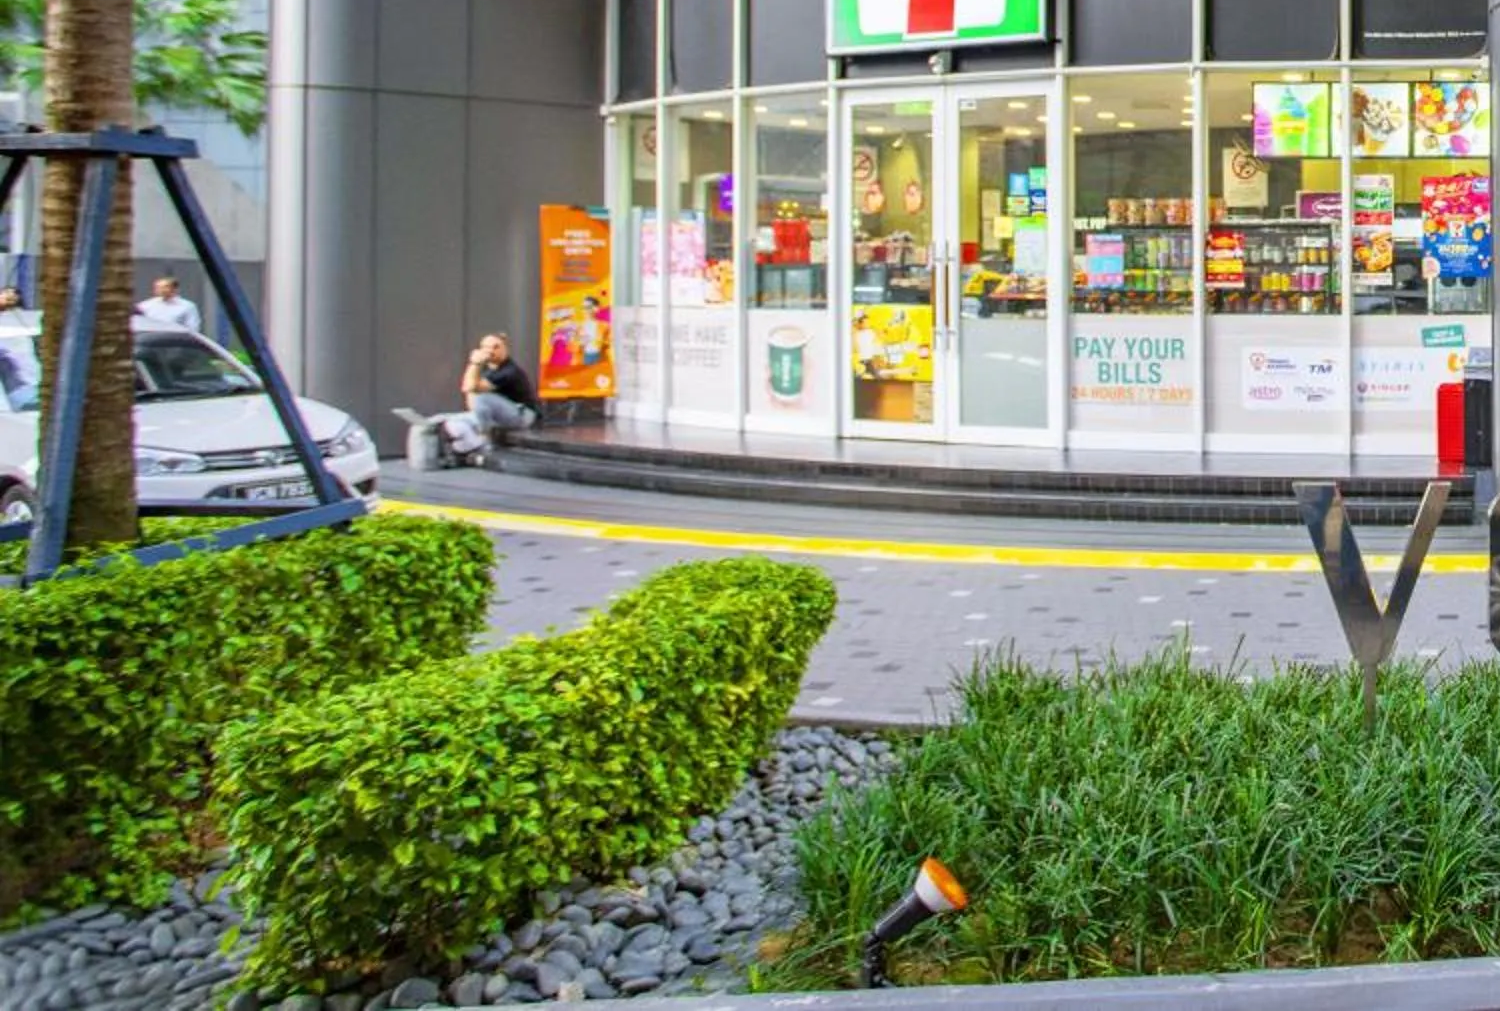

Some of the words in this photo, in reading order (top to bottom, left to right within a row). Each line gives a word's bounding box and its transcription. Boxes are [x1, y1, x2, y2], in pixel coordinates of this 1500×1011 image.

[1074, 336, 1116, 359] PAY
[1123, 336, 1185, 360] YOUR
[1098, 362, 1163, 384] BILLS
